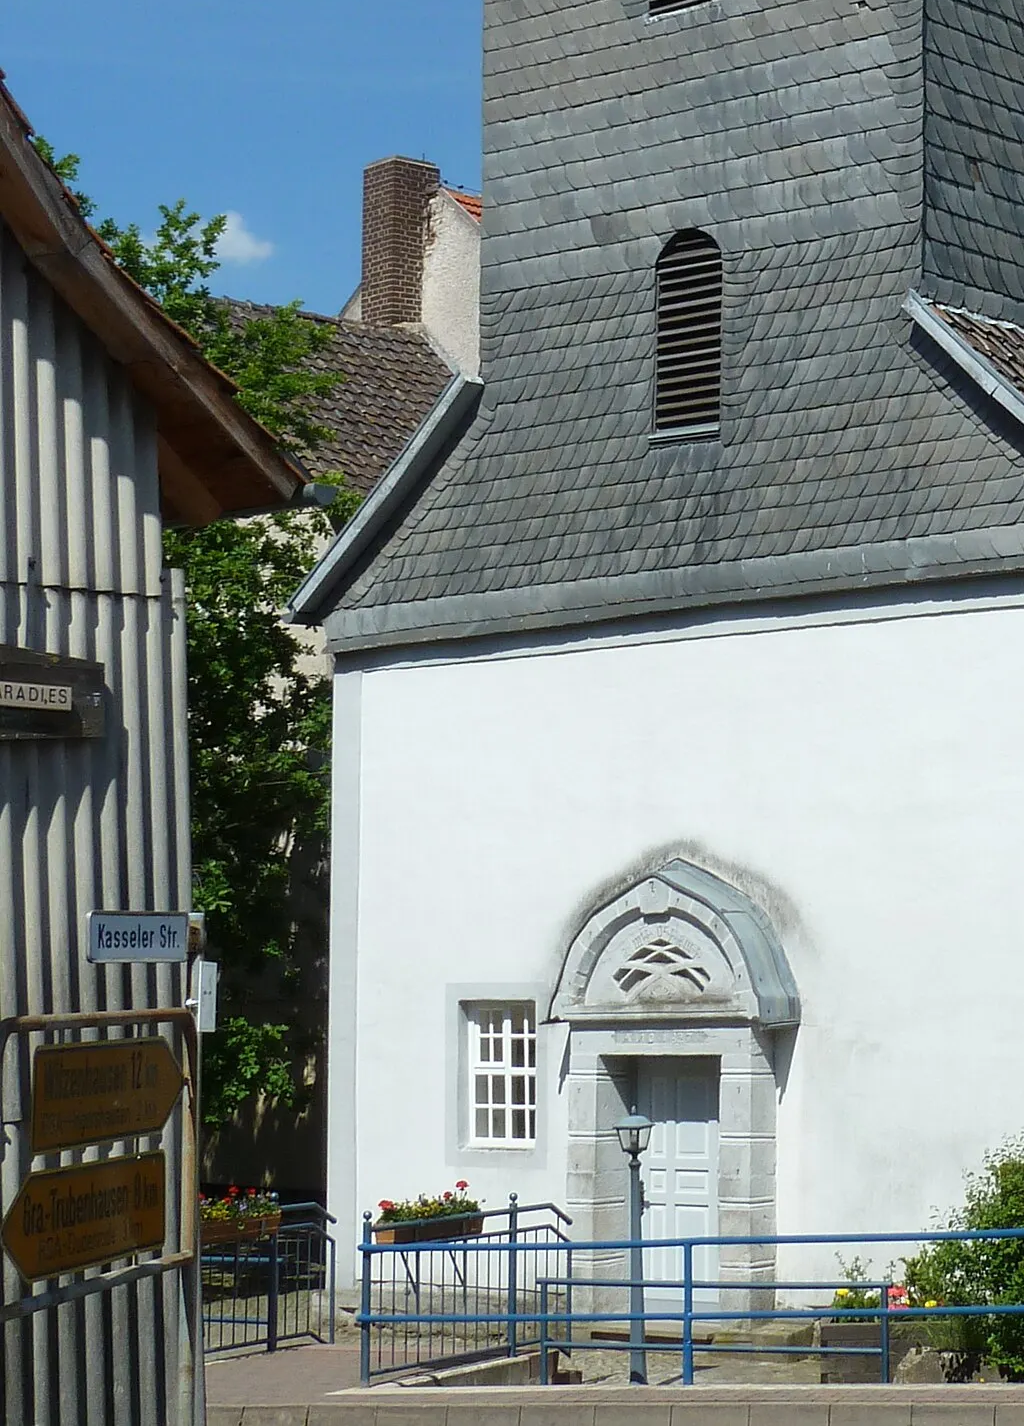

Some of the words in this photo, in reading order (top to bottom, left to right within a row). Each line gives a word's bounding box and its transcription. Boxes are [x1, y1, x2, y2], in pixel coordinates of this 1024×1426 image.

[97, 923, 155, 949] Kasseler
[160, 924, 180, 949] Str.
[131, 1049, 142, 1089] 12
